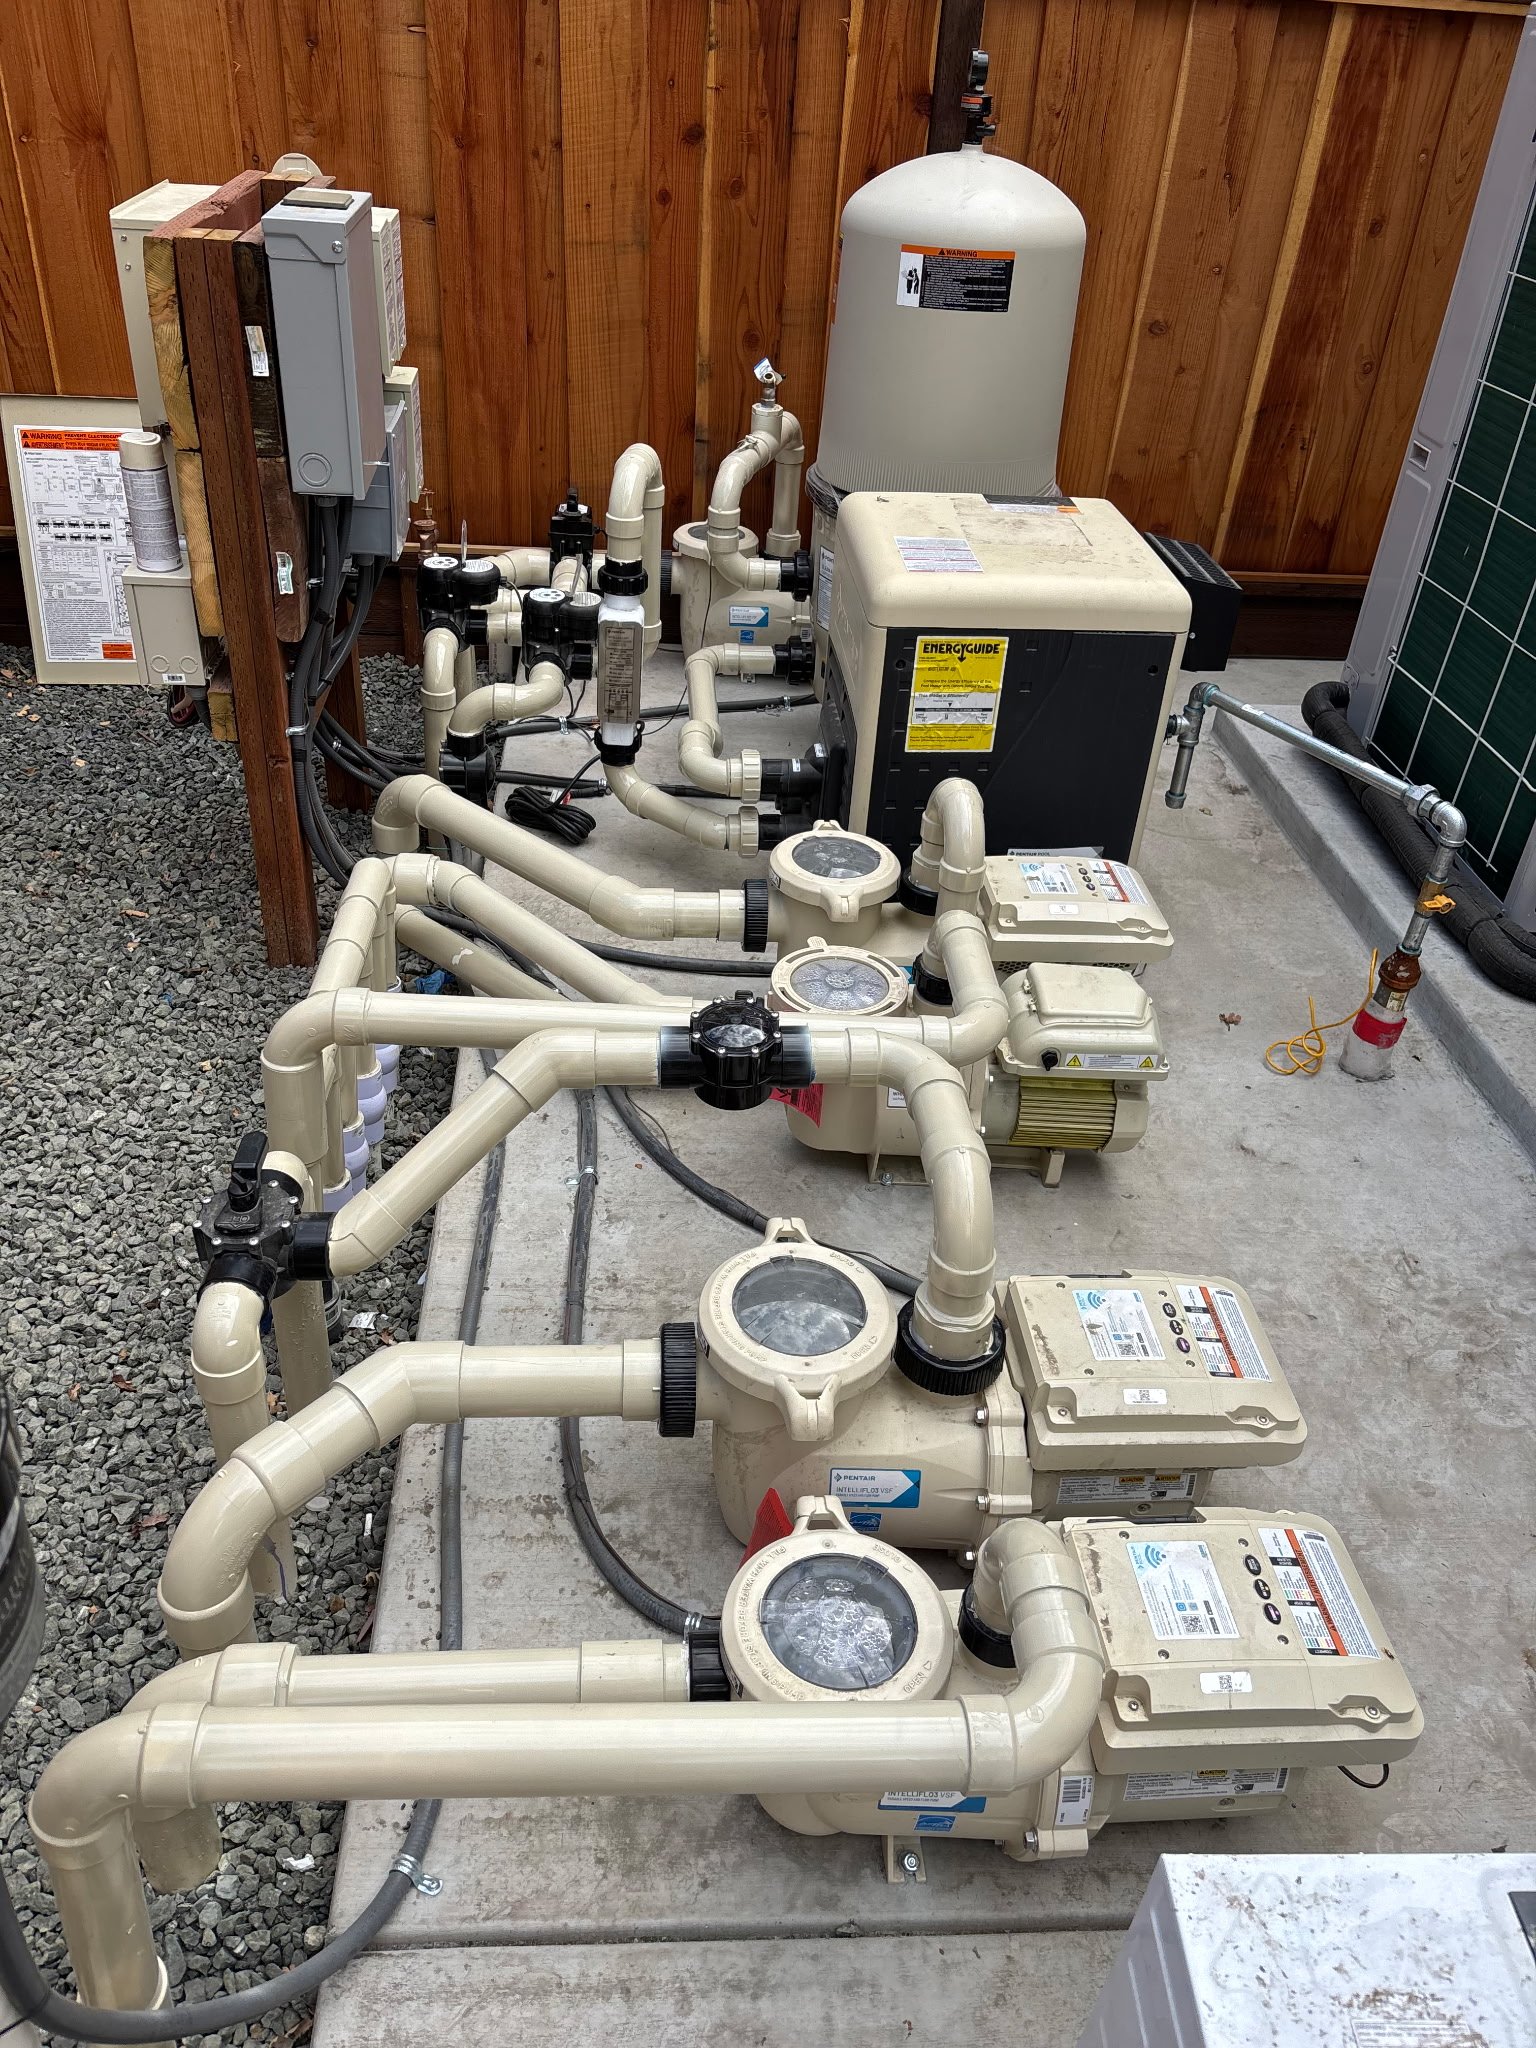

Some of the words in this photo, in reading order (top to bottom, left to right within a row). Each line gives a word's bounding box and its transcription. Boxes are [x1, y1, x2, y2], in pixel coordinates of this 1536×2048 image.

[946, 249, 978, 258] WARNING
[923, 643, 1000, 656] ENERGYGUIDE
[1295, 1548, 1323, 1594] AVERTISSEMENT
[1314, 1597, 1334, 1625] WARNING
[902, 1671, 927, 1694] OPEN
